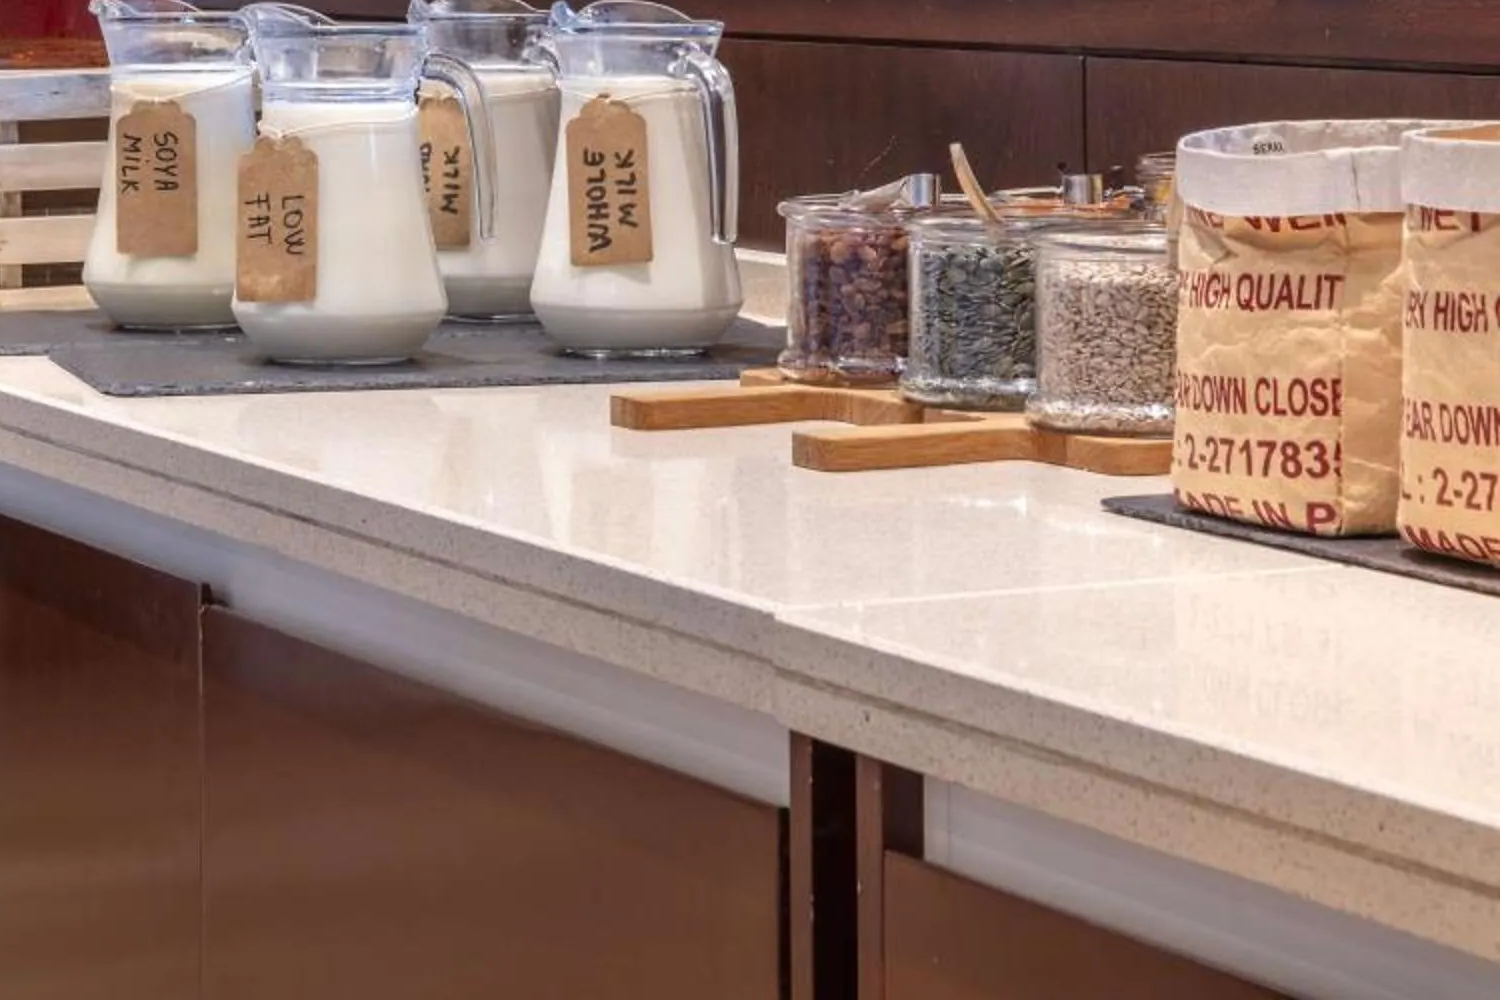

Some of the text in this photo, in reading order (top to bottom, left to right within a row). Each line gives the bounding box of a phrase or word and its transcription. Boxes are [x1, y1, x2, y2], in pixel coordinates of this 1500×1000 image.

[121, 133, 143, 194] MILK
[154, 131, 180, 192] SOYA
[440, 145, 461, 215] MILK
[614, 149, 638, 228] MILK
[244, 192, 273, 245] FAT
[281, 195, 305, 256] LOW
[583, 148, 612, 253] WHOLE
[1189, 272, 1231, 309] HIGH
[1433, 290, 1489, 333] HIGH
[1192, 374, 1247, 415] DOWN
[1251, 499, 1295, 530] IN
[1433, 466, 1498, 512] 2-27
